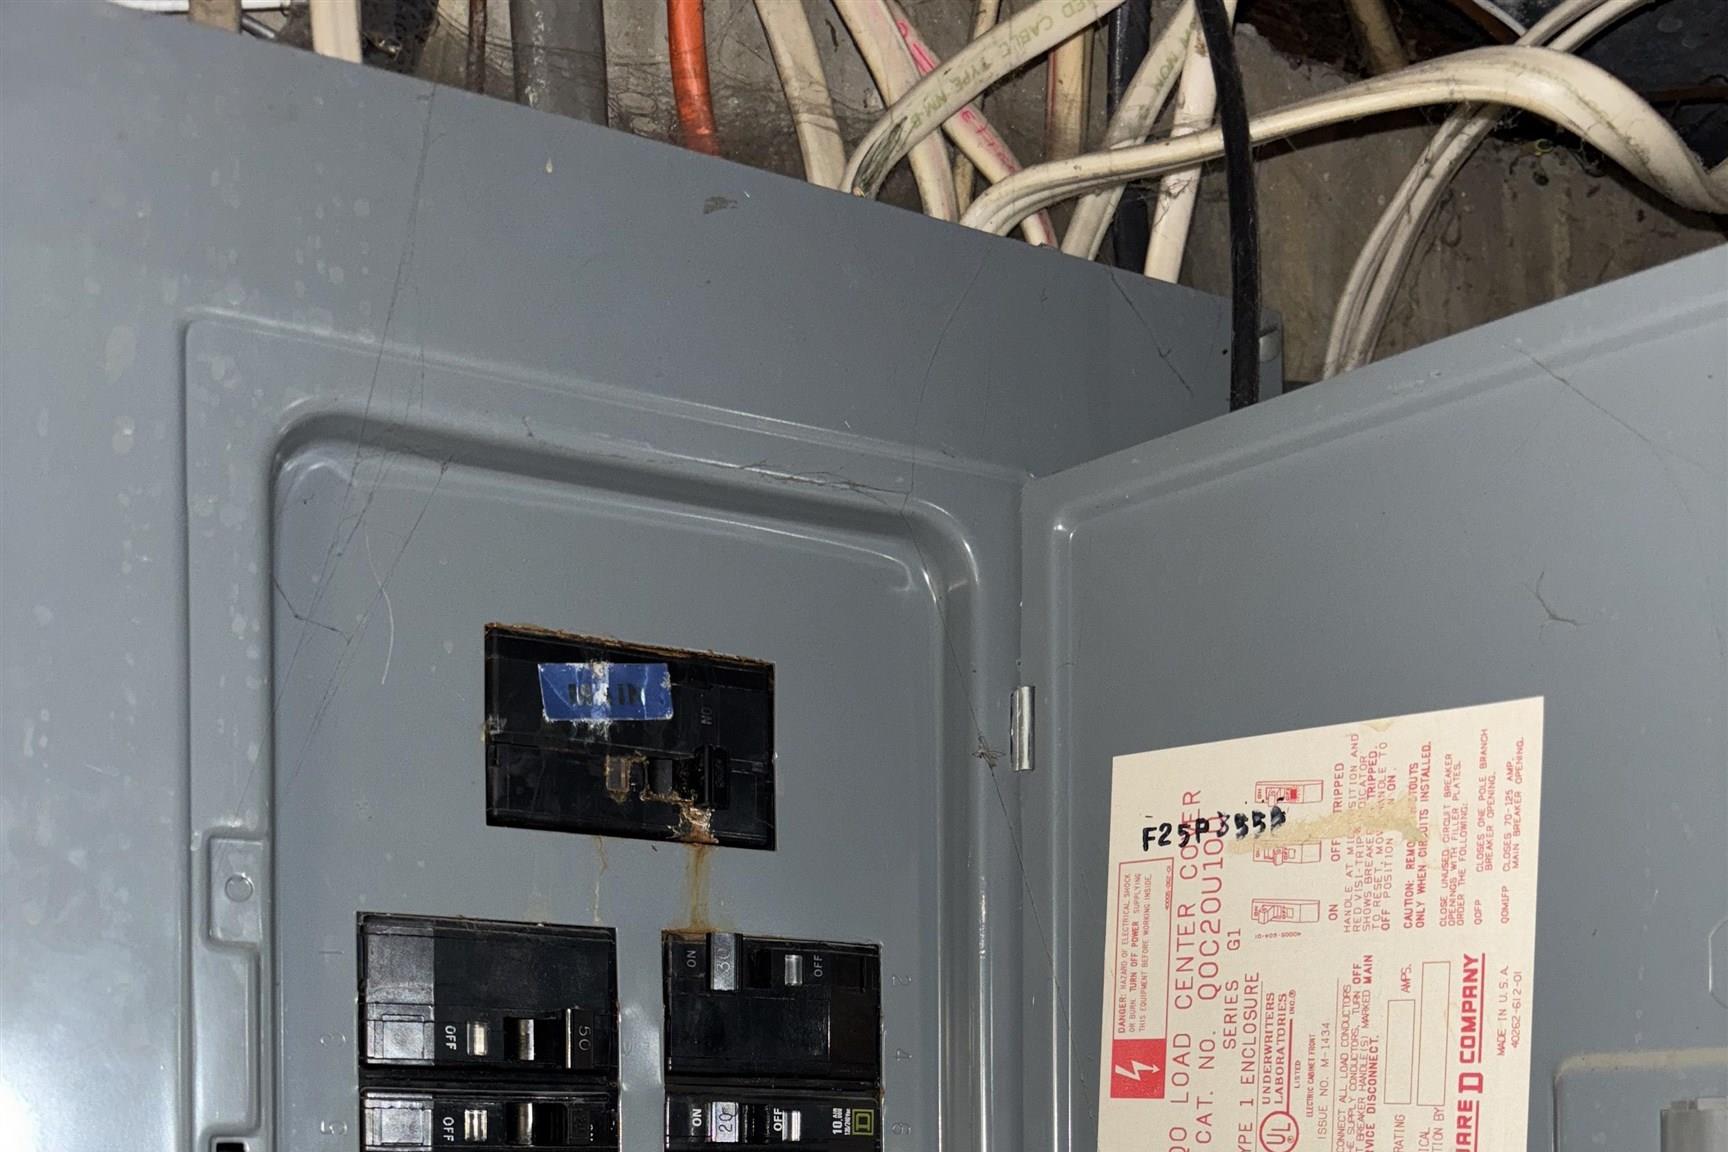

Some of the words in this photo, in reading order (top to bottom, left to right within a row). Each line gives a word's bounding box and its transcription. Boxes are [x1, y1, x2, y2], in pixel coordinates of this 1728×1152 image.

[1420, 741, 1432, 802] INSTALLED.
[1333, 763, 1344, 814] TRIPPED
[1330, 839, 1341, 862] OFF
[1328, 904, 1338, 921] ON
[1403, 880, 1415, 929] CAUTION:
[1131, 919, 1139, 948] POWER
[1227, 928, 1241, 951] G1
[686, 950, 696, 968] ON
[813, 954, 824, 978] OFF
[1130, 952, 1139, 968] OFF
[1174, 903, 1196, 1010] CENTER
[1129, 971, 1138, 993] TURN
[1118, 992, 1126, 1034] DANGER:
[1223, 979, 1239, 1050] SERIES
[1459, 953, 1479, 1064] COMPANY
[1498, 1009, 1507, 1022] IN
[1511, 971, 1522, 1049] 40262-612-01
[444, 1025, 457, 1051] OFF
[578, 1025, 592, 1052] 50
[1241, 972, 1260, 1085] ENCLOSURE
[1497, 1030, 1506, 1056] MADE
[1199, 1031, 1216, 1070] NO.
[1262, 992, 1275, 1105] UNDERWRITERS
[1274, 993, 1288, 1105] LABORATORIES
[1321, 1022, 1331, 1069] M-1434
[1171, 1033, 1191, 1104] LOAD
[1366, 1035, 1379, 1114] DISCONNECT.
[1458, 1072, 1484, 1094] D
[1320, 1076, 1329, 1096] NO.
[1195, 1091, 1214, 1144] CAT.
[1240, 1098, 1254, 1107] 1
[442, 1116, 455, 1142] OFF
[692, 1108, 702, 1127] ON
[718, 1111, 734, 1133] 20
[773, 1108, 783, 1132] OFF
[1318, 1104, 1328, 1140] ISSUE
